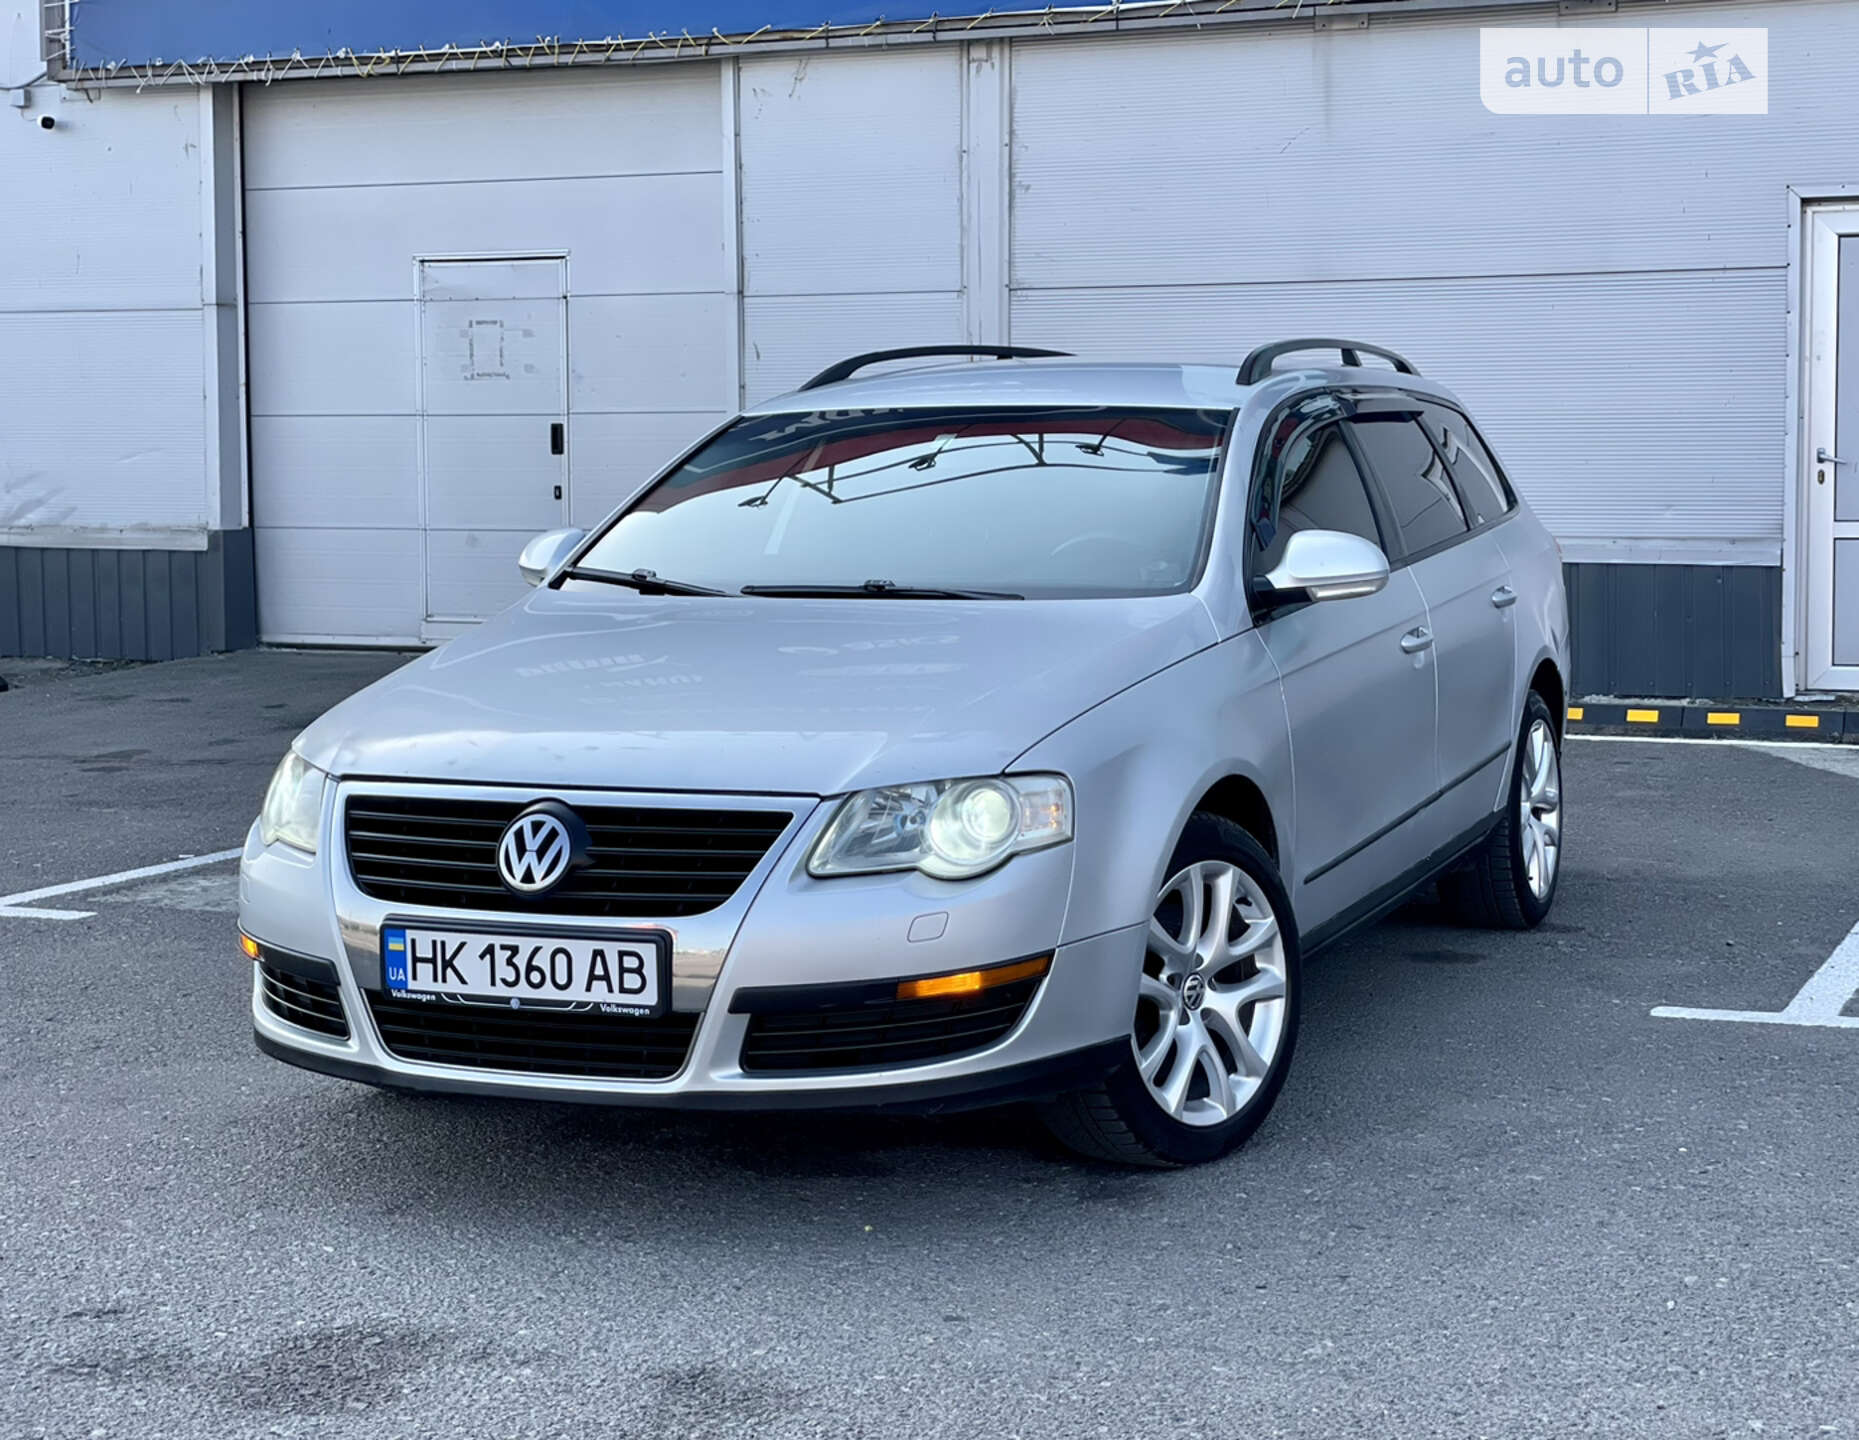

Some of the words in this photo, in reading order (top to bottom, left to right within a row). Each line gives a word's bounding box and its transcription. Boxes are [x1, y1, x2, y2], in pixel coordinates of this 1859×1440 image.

[500, 813, 570, 892] VW
[410, 937, 468, 985] HK
[478, 943, 574, 991] 1360
[585, 948, 649, 996] AB
[388, 967, 406, 981] UA
[391, 989, 436, 1002] Volkswagen
[600, 1003, 650, 1016] Volkswagen
